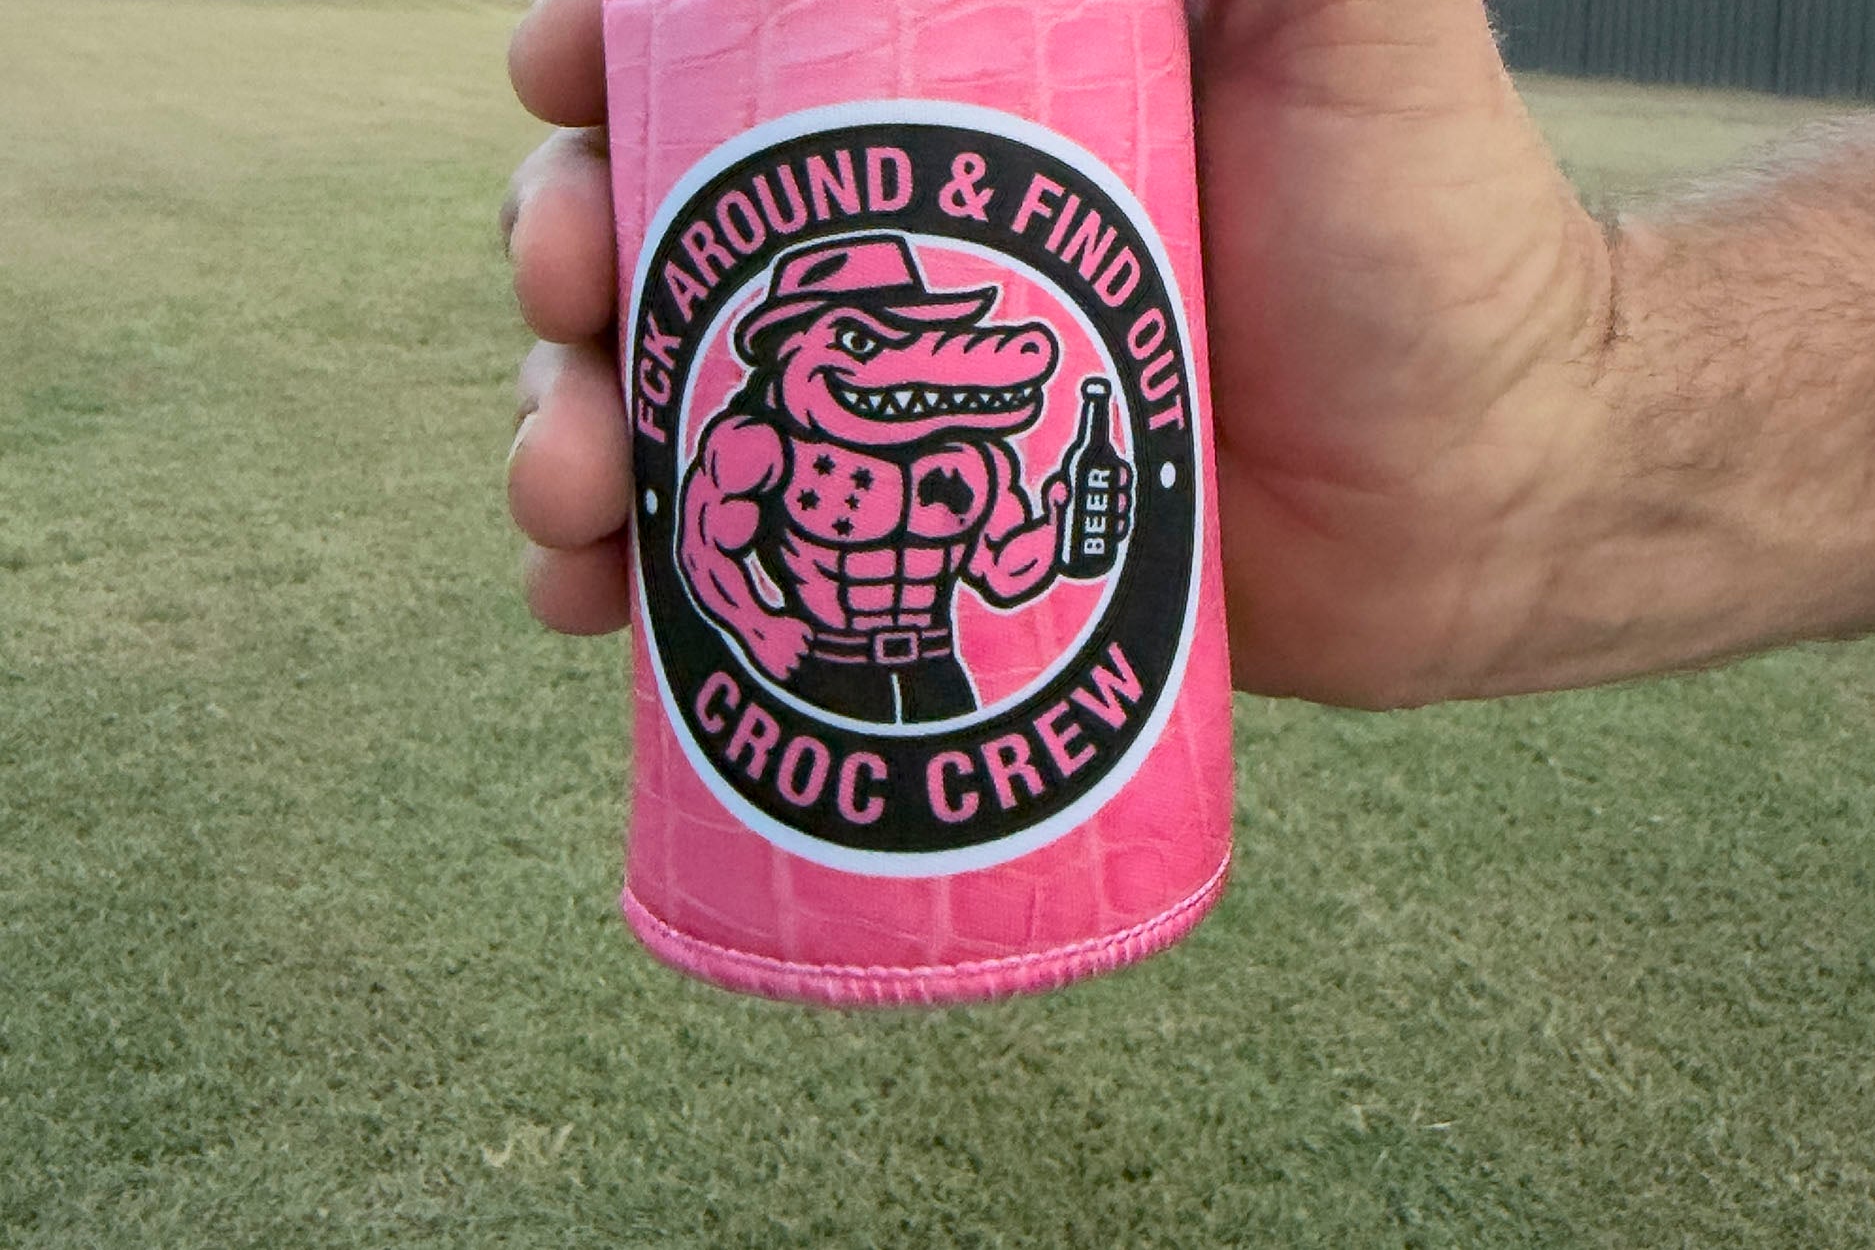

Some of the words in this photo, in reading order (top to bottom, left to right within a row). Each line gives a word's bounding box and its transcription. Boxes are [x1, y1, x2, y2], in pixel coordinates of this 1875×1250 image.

[636, 313, 681, 444] FCK
[661, 147, 914, 323] AROUND
[939, 152, 995, 220] &
[1012, 172, 1142, 308] FIND
[1130, 309, 1187, 431] OUT
[1085, 467, 1109, 557] BEER
[694, 669, 887, 825] CROC
[926, 641, 1144, 823] CREW
